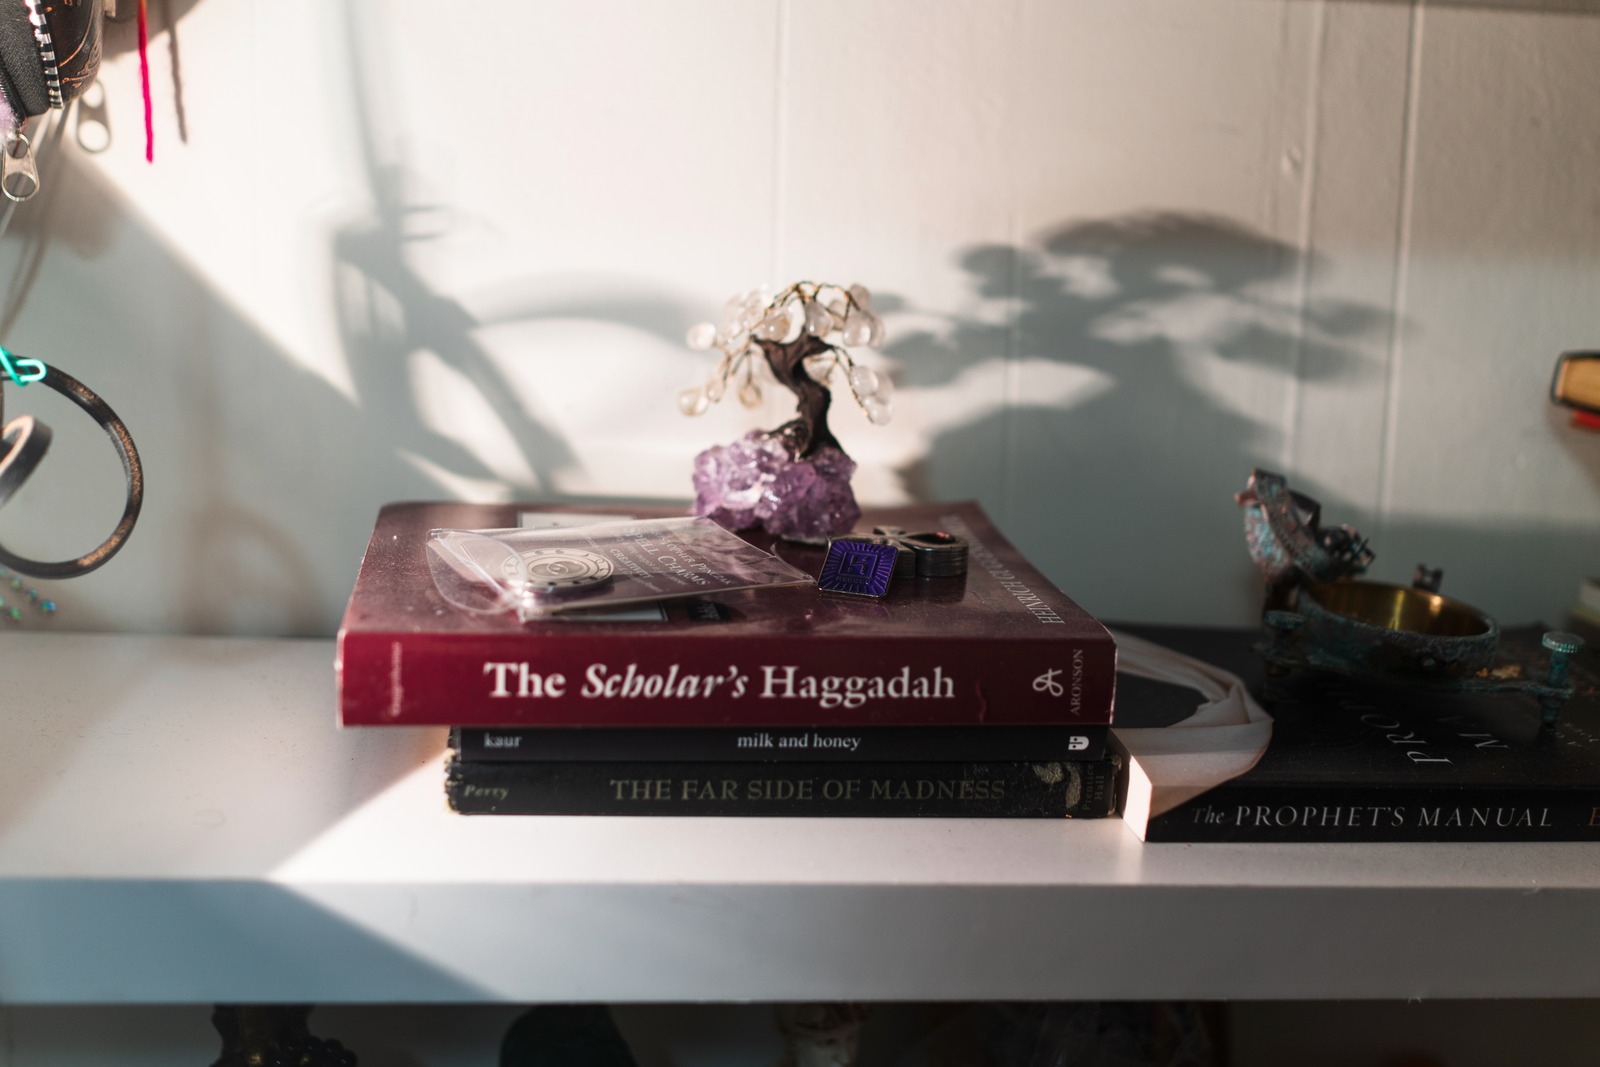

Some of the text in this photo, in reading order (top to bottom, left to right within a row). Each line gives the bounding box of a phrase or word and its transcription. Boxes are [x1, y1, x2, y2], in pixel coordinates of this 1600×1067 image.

[1001, 580, 1065, 624] HEINRICH
[483, 662, 955, 708] The Scholar's Haggadah
[1070, 649, 1084, 716] ARONSON
[484, 734, 521, 748] kaur
[737, 733, 861, 751] milk and honey
[609, 779, 1006, 801] THE FAR SIDE OF MADNESS
[1191, 805, 1225, 824] The
[1235, 805, 1405, 827] PROPHET'S
[1418, 807, 1553, 828] MANUAL
